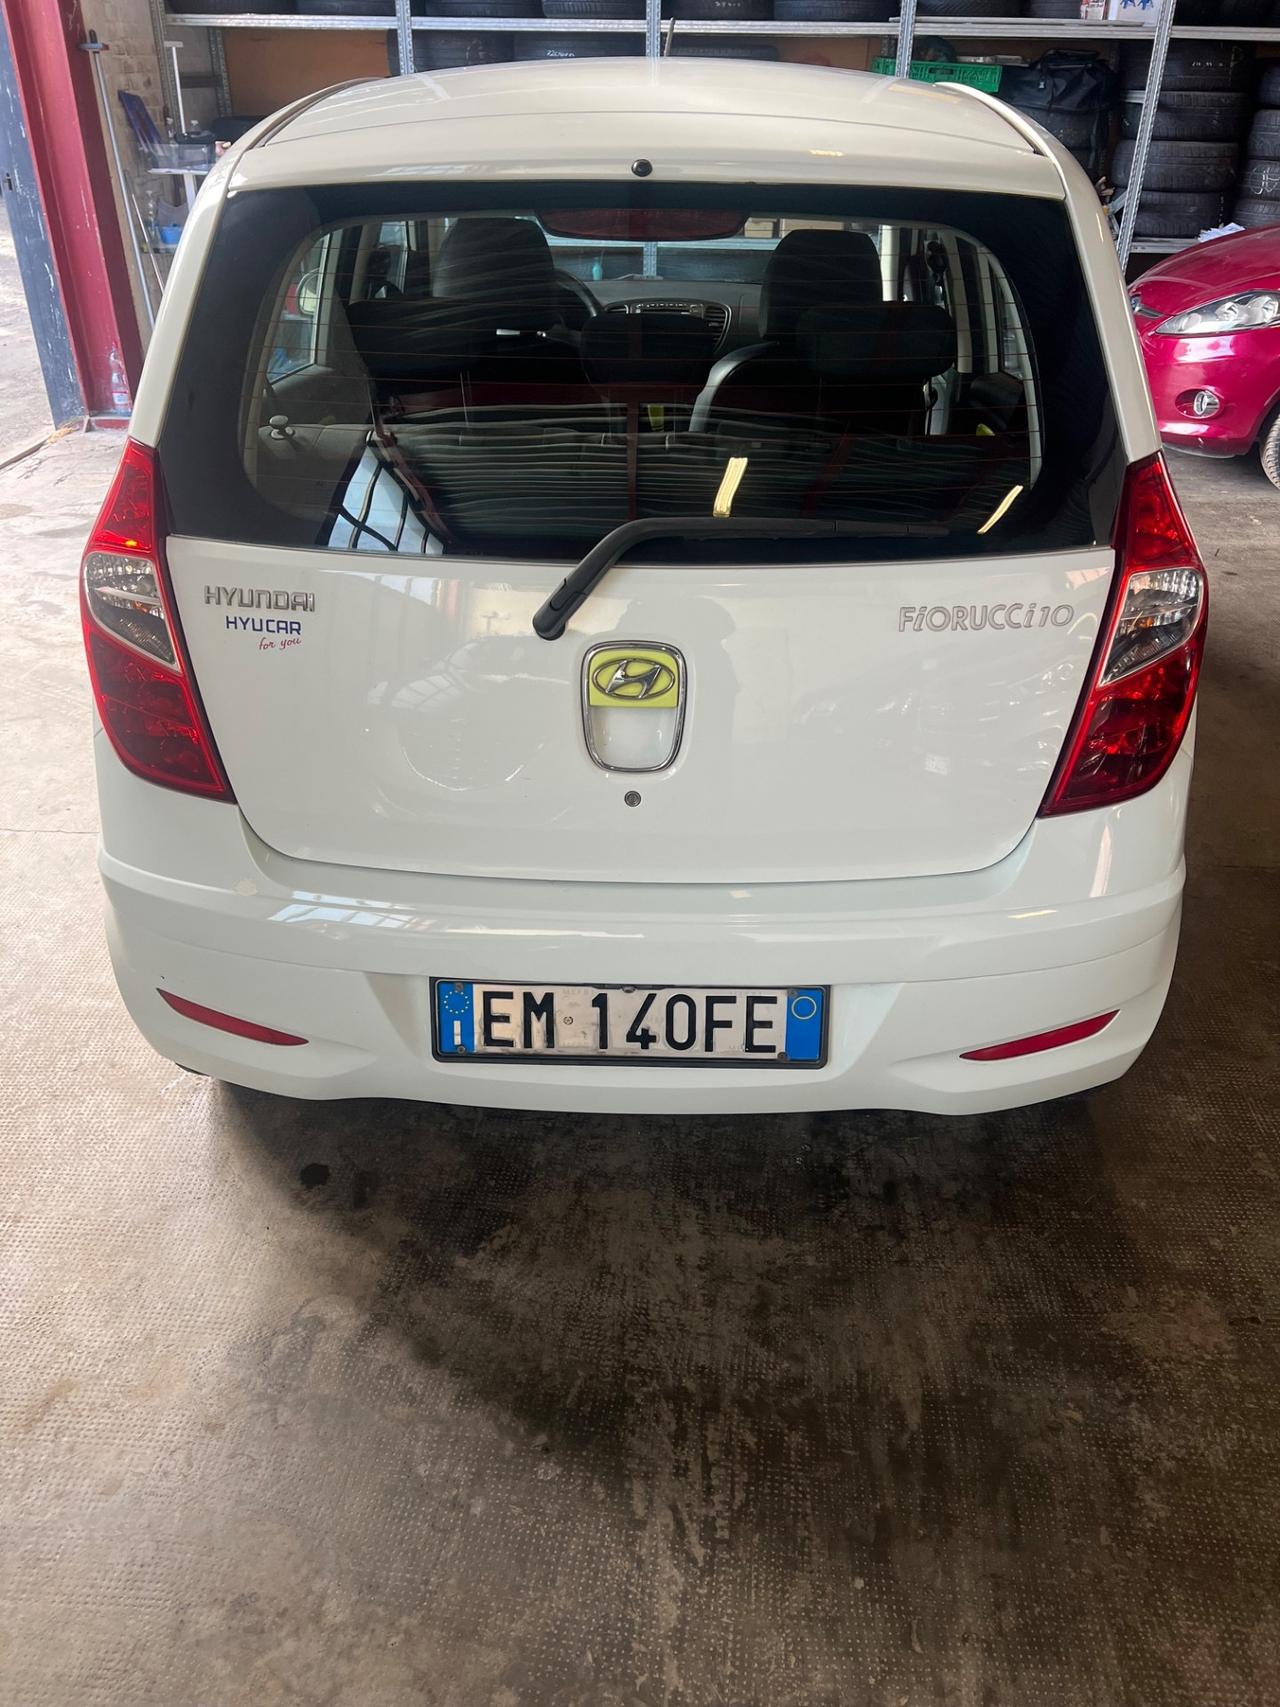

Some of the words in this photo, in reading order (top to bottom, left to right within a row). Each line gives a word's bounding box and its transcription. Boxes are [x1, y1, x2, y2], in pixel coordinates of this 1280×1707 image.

[204, 585, 315, 612] HYUNDAI
[225, 616, 302, 635] HYUCAR
[258, 637, 276, 650] for
[280, 637, 302, 650] you
[482, 991, 556, 1049] EM
[591, 993, 779, 1053] 140FE
